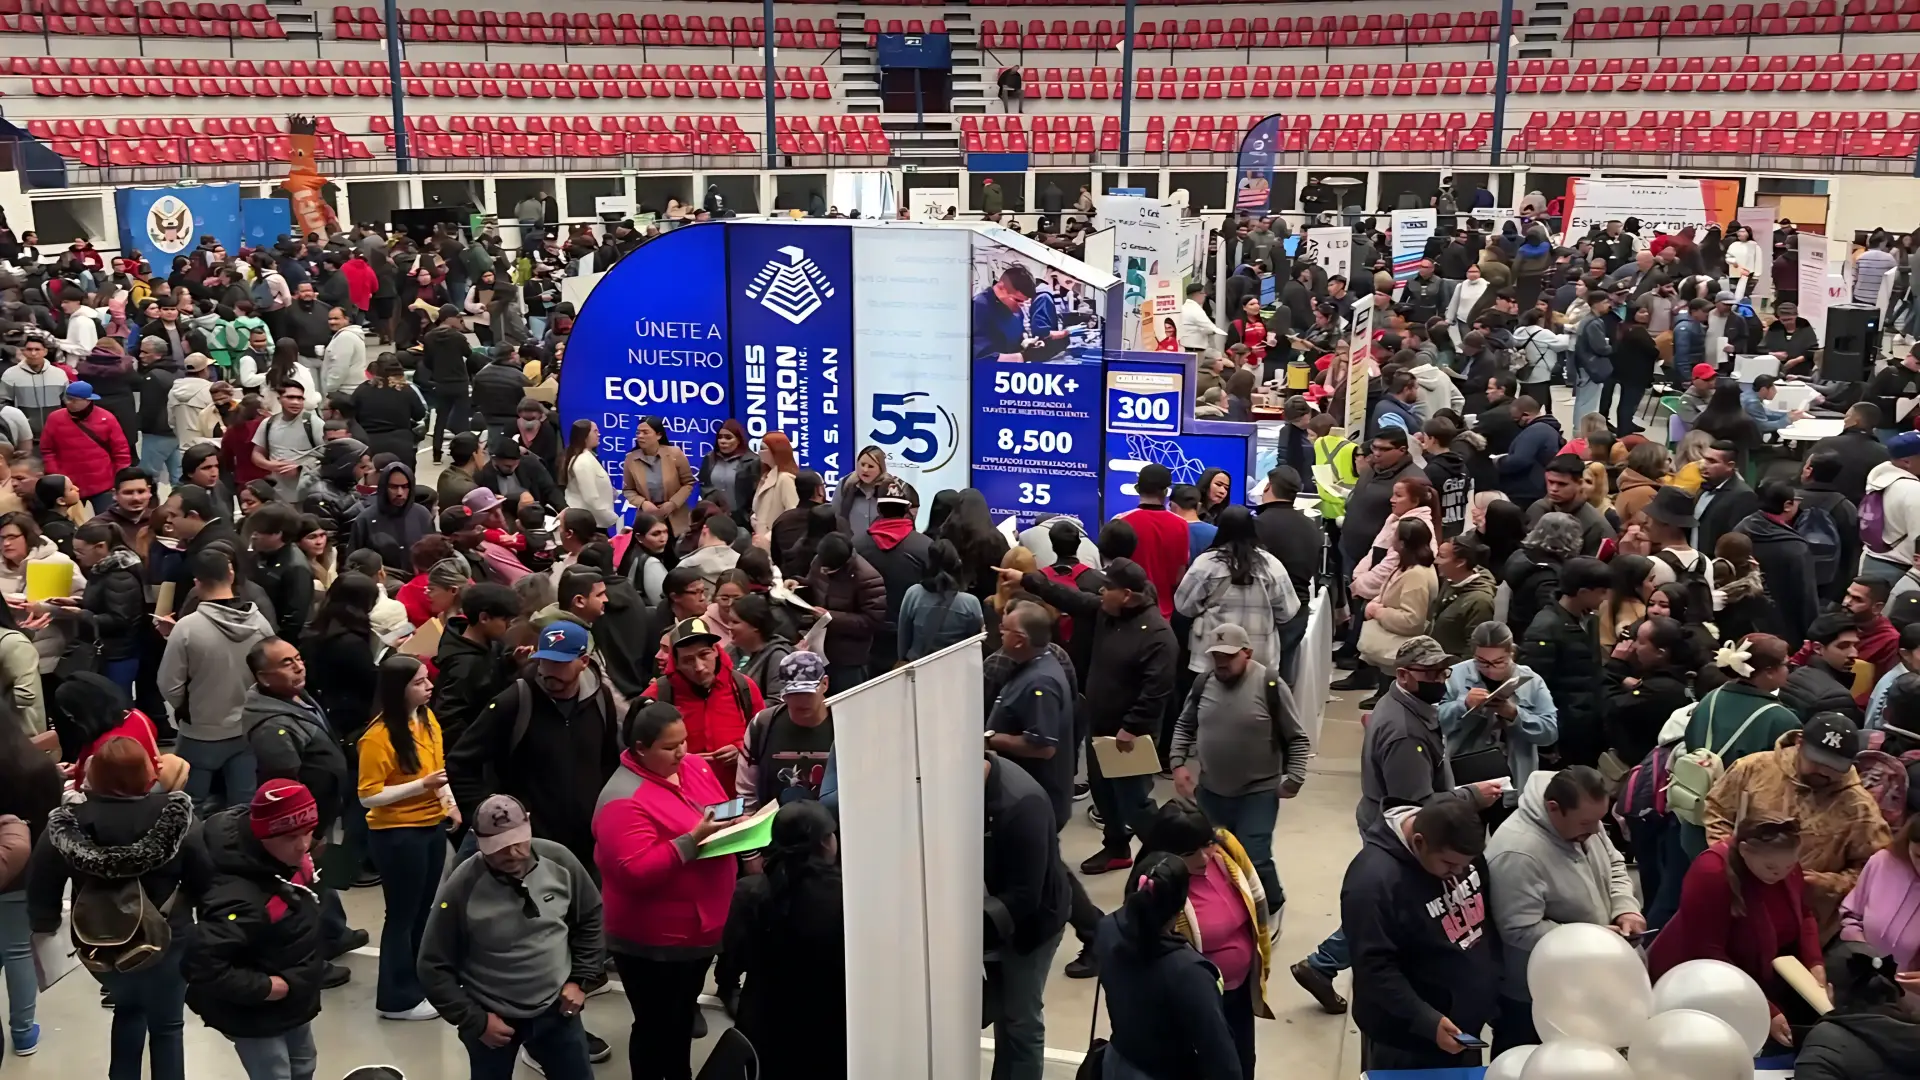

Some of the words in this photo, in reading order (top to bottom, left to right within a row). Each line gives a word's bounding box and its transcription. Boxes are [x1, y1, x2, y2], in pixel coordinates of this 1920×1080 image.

[635, 317, 702, 339] ÚNETE
[707, 323, 722, 340] A
[628, 349, 723, 368] NUESTRO
[605, 377, 725, 406] EQUIPO
[822, 347, 839, 414] PLAN
[994, 371, 1079, 396] 500K+
[745, 345, 768, 454] ONIES
[1117, 396, 1170, 421] 300
[603, 412, 630, 430] DE
[869, 393, 938, 463] 55
[602, 436, 625, 453] SE
[997, 428, 1072, 454] 8,500
[1018, 482, 1051, 505] 35
